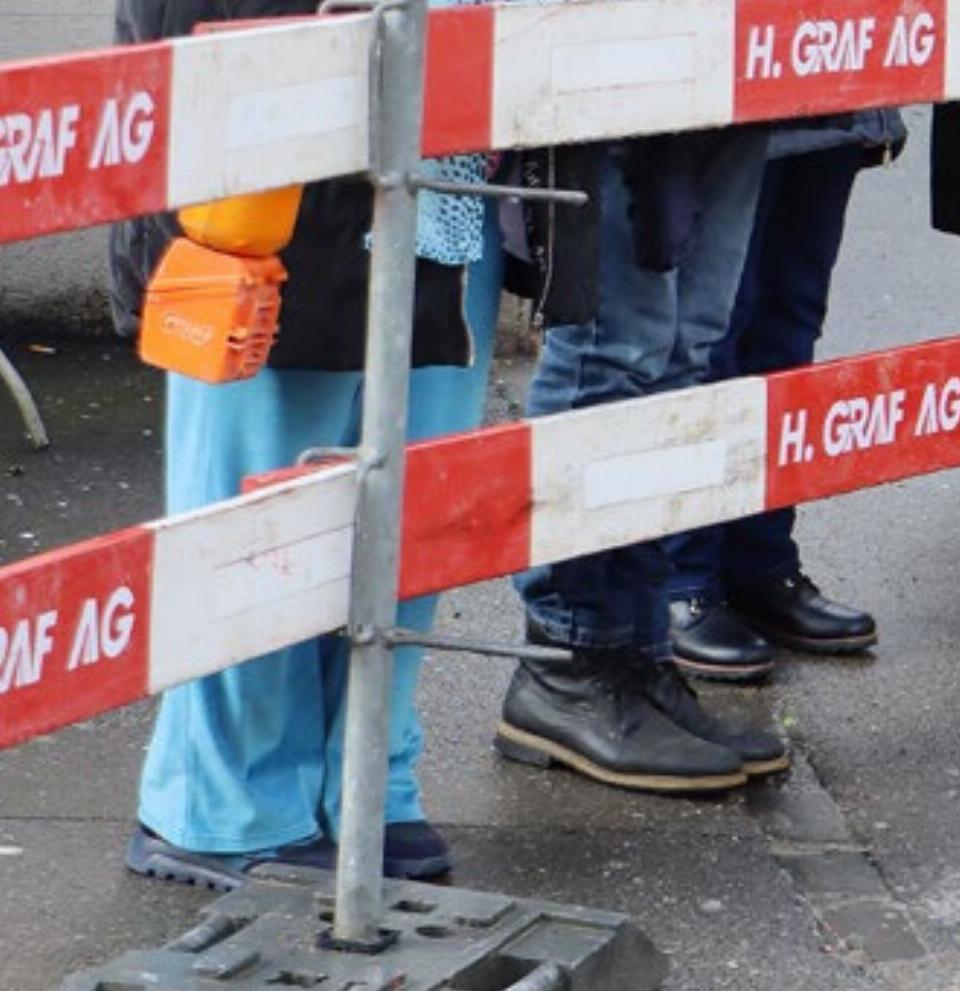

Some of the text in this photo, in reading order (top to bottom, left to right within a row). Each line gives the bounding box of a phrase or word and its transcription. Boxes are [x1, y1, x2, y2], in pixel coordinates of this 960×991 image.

[745, 11, 935, 80] H. GRAF AG
[0, 90, 155, 187] RAF AG
[777, 409, 815, 467] H.
[822, 389, 906, 458] GRAF
[67, 586, 135, 671] AG
